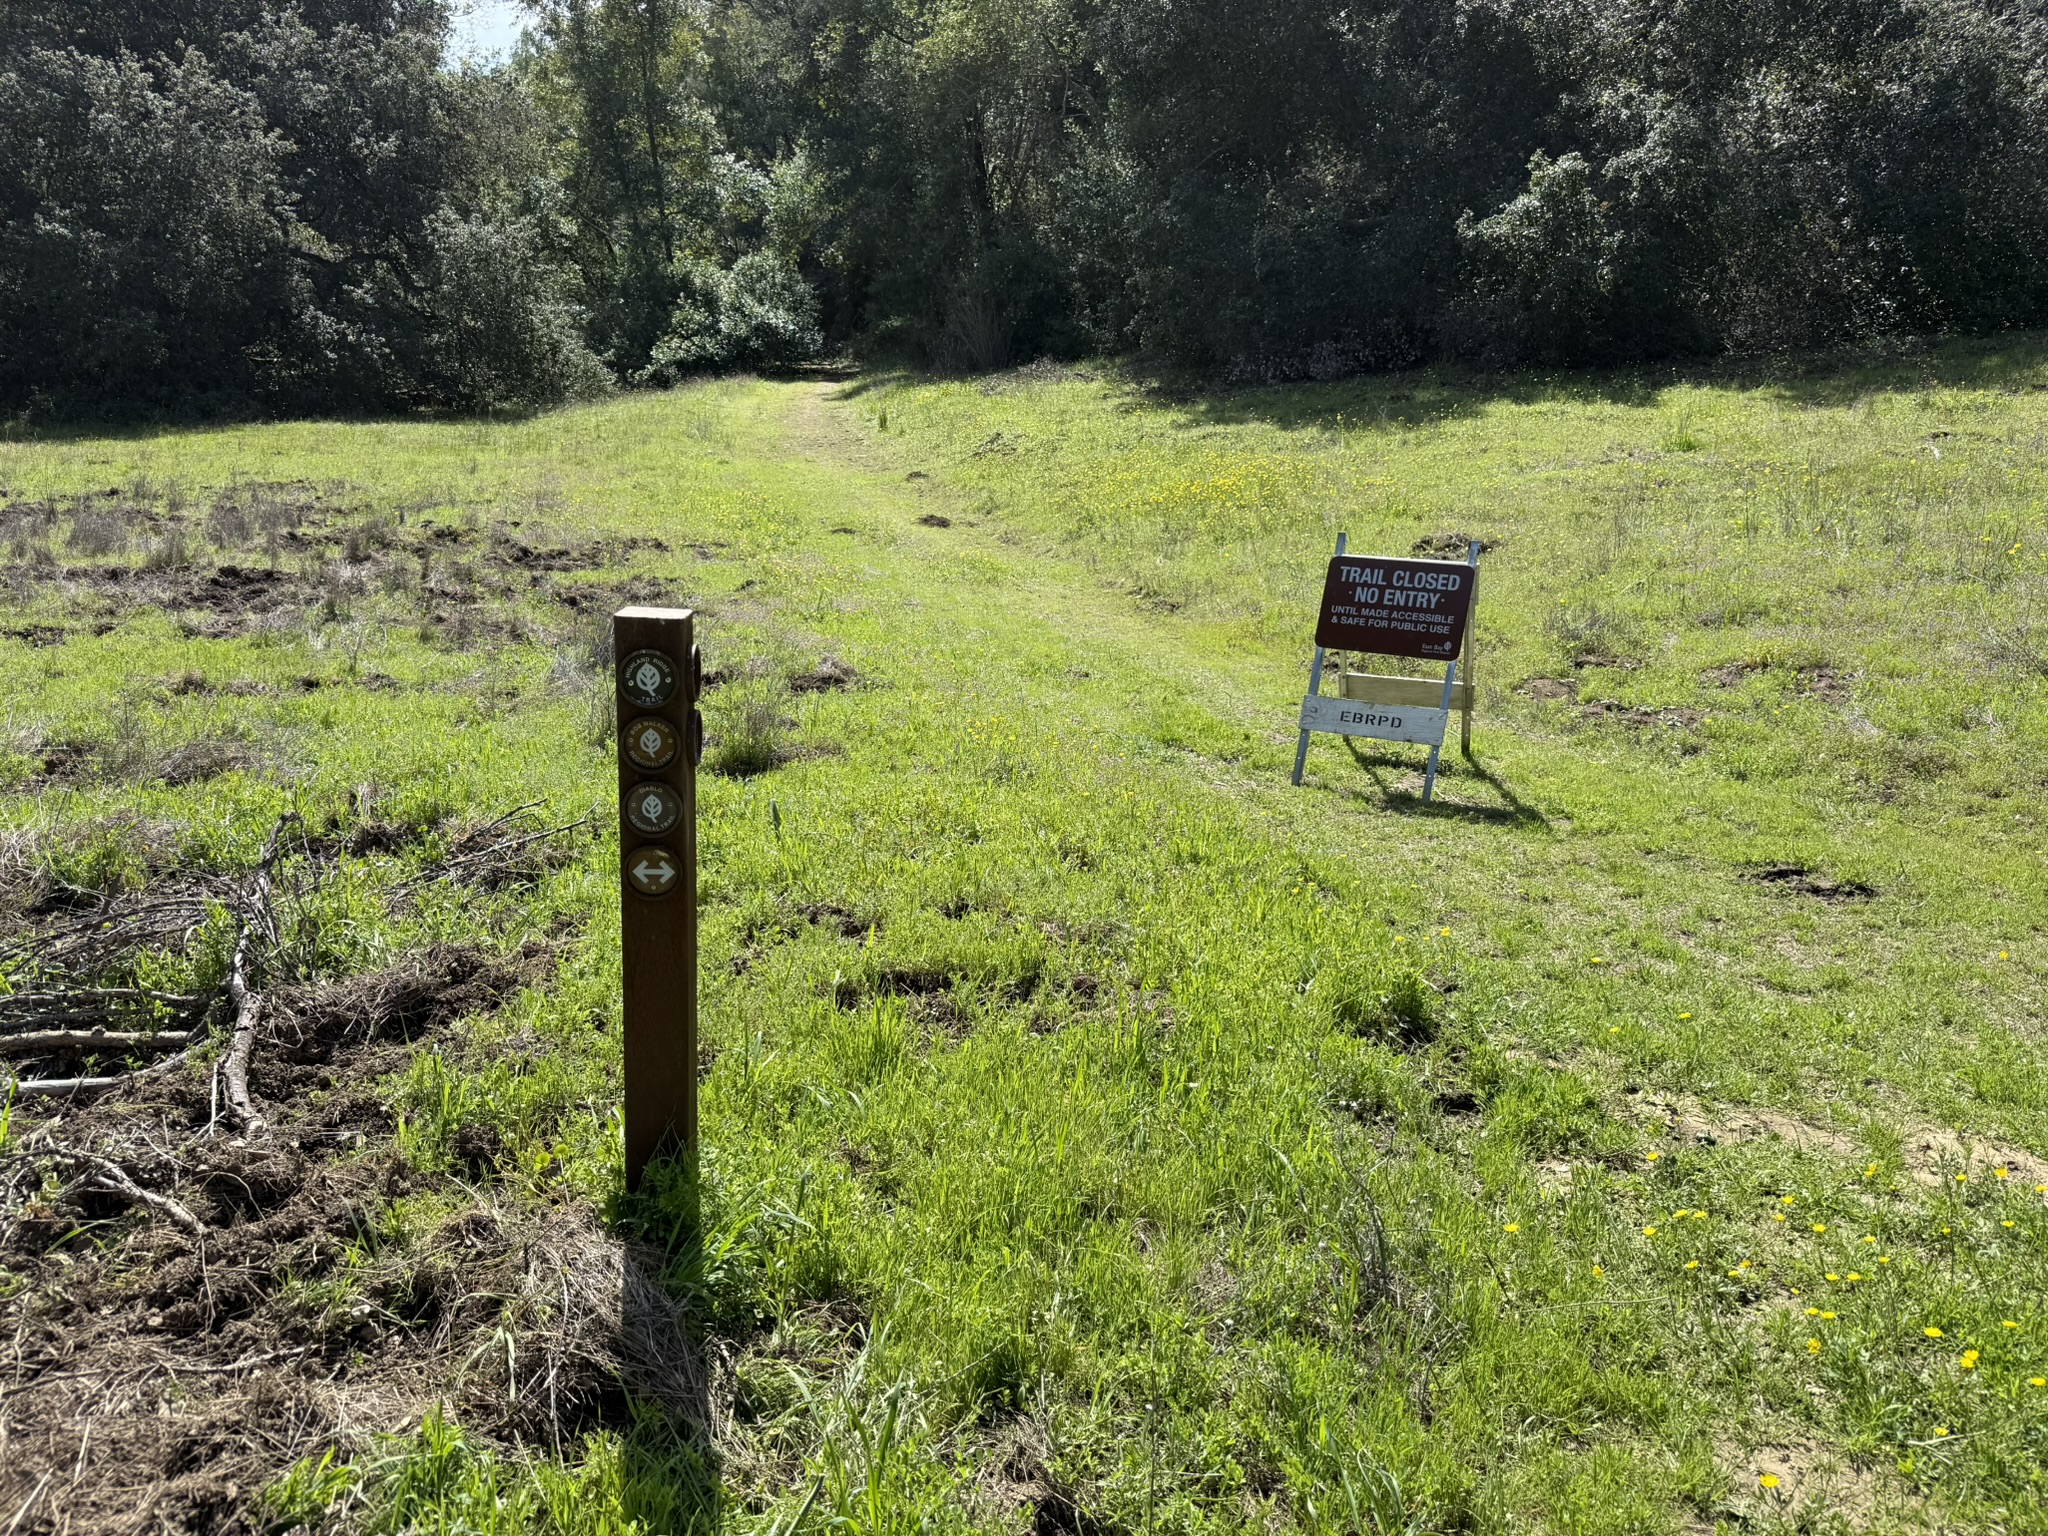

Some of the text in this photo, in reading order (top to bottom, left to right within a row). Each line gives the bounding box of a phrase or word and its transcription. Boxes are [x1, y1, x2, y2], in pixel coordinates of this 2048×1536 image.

[1340, 565, 1461, 591] TRAIL CLOSED
[1354, 586, 1440, 609] NO ENTRY
[1331, 605, 1455, 624] UNTIL MADE ACCESSIBLE
[1331, 615, 1450, 634] & SAFE FOR PUBLIC USE
[625, 656, 670, 678] HIGHLAND RIDGE
[630, 721, 670, 735] BOB WALKER
[1340, 710, 1402, 729] EBRPD
[629, 750, 674, 767] REGIONAL TRAIL
[638, 785, 663, 793] DIABLO
[630, 815, 675, 831] REGIONAL TRAIL
